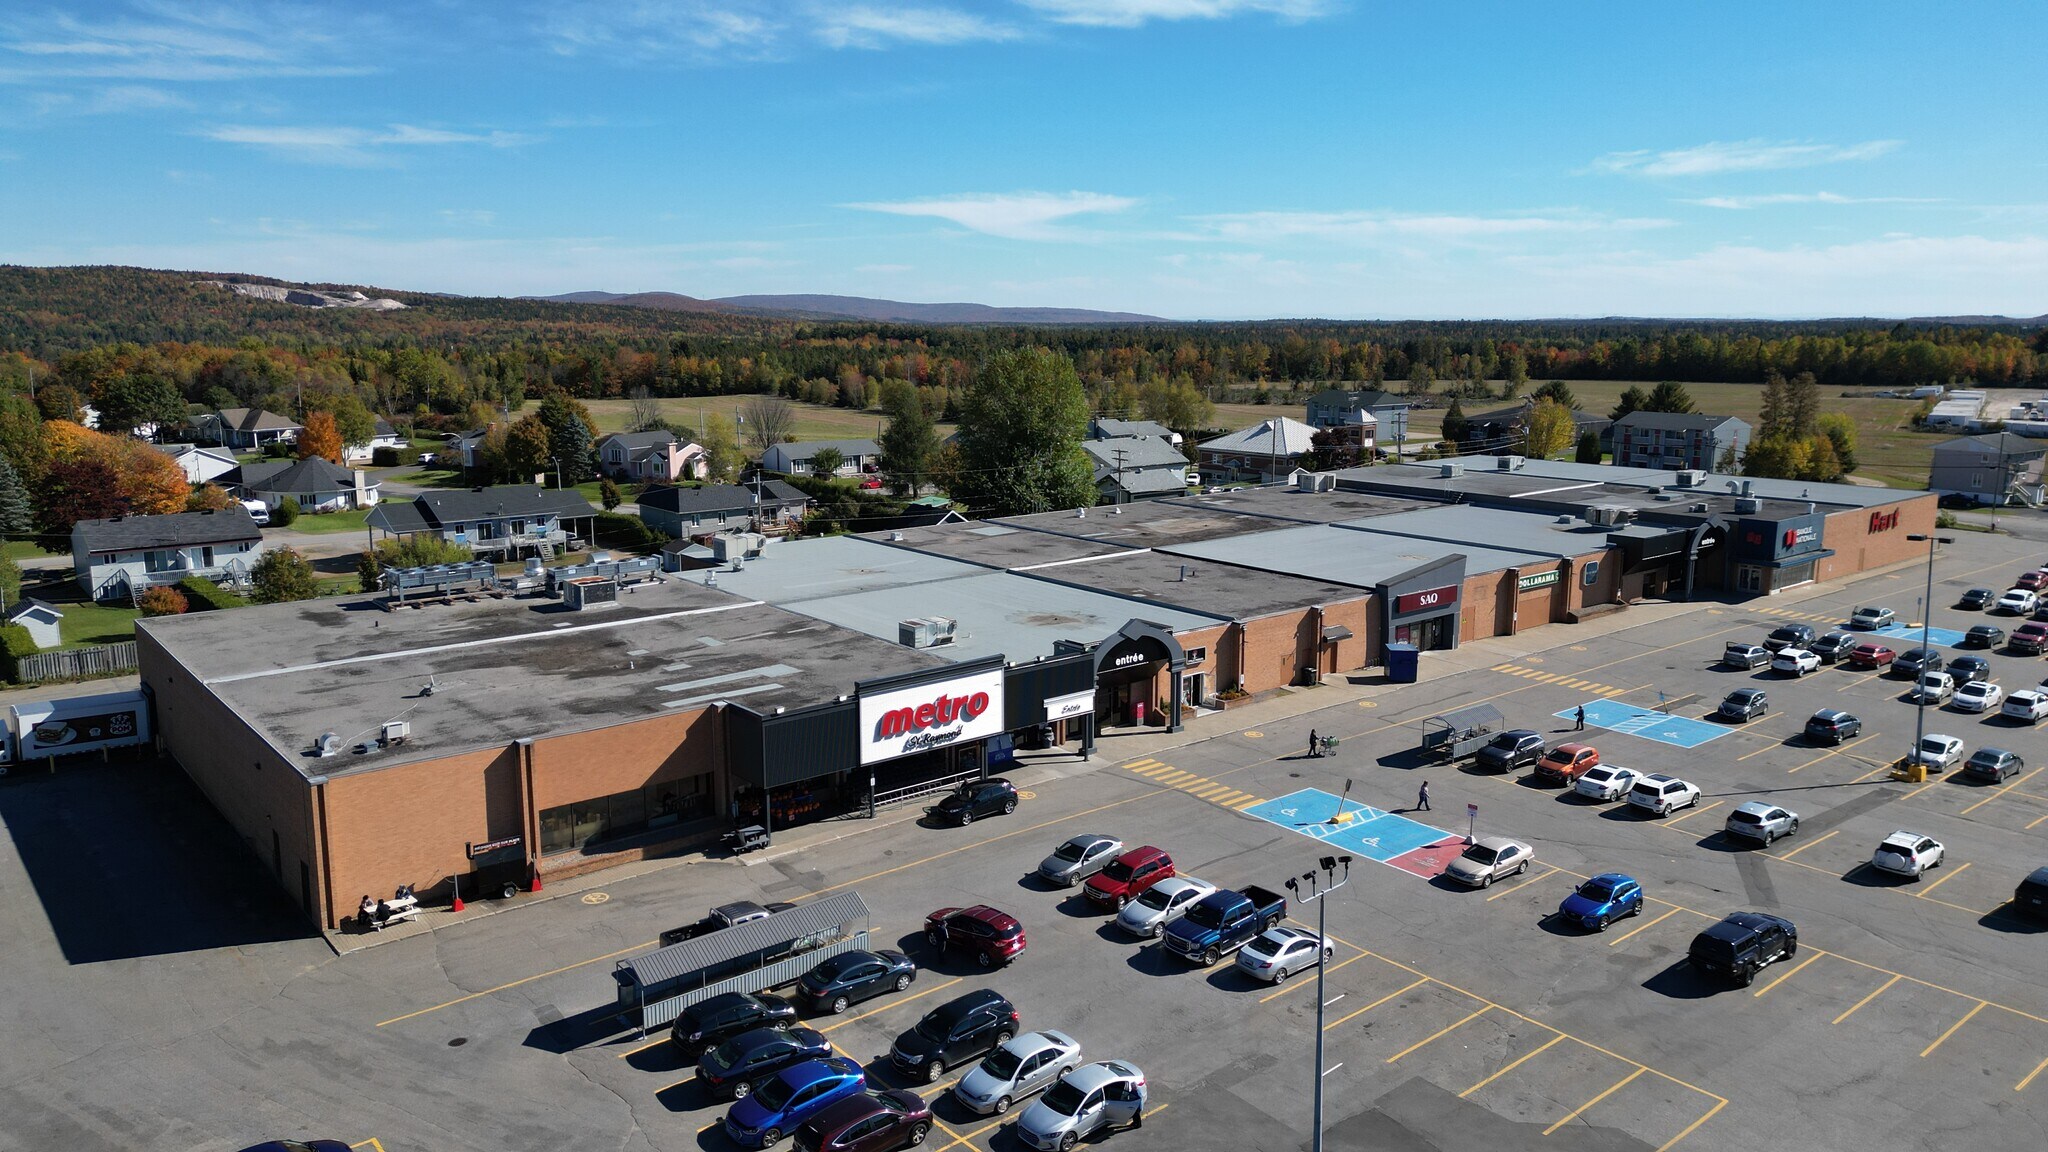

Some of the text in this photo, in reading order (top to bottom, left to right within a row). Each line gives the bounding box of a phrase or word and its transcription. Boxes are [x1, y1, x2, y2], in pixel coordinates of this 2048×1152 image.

[1870, 508, 1900, 532] Hart
[1796, 526, 1813, 535] BANQUE
[1796, 533, 1816, 543] NATIONALE
[1420, 592, 1438, 605] SAO
[1115, 652, 1144, 666] entrée
[880, 691, 989, 737] metro
[1061, 703, 1081, 715] Entrée
